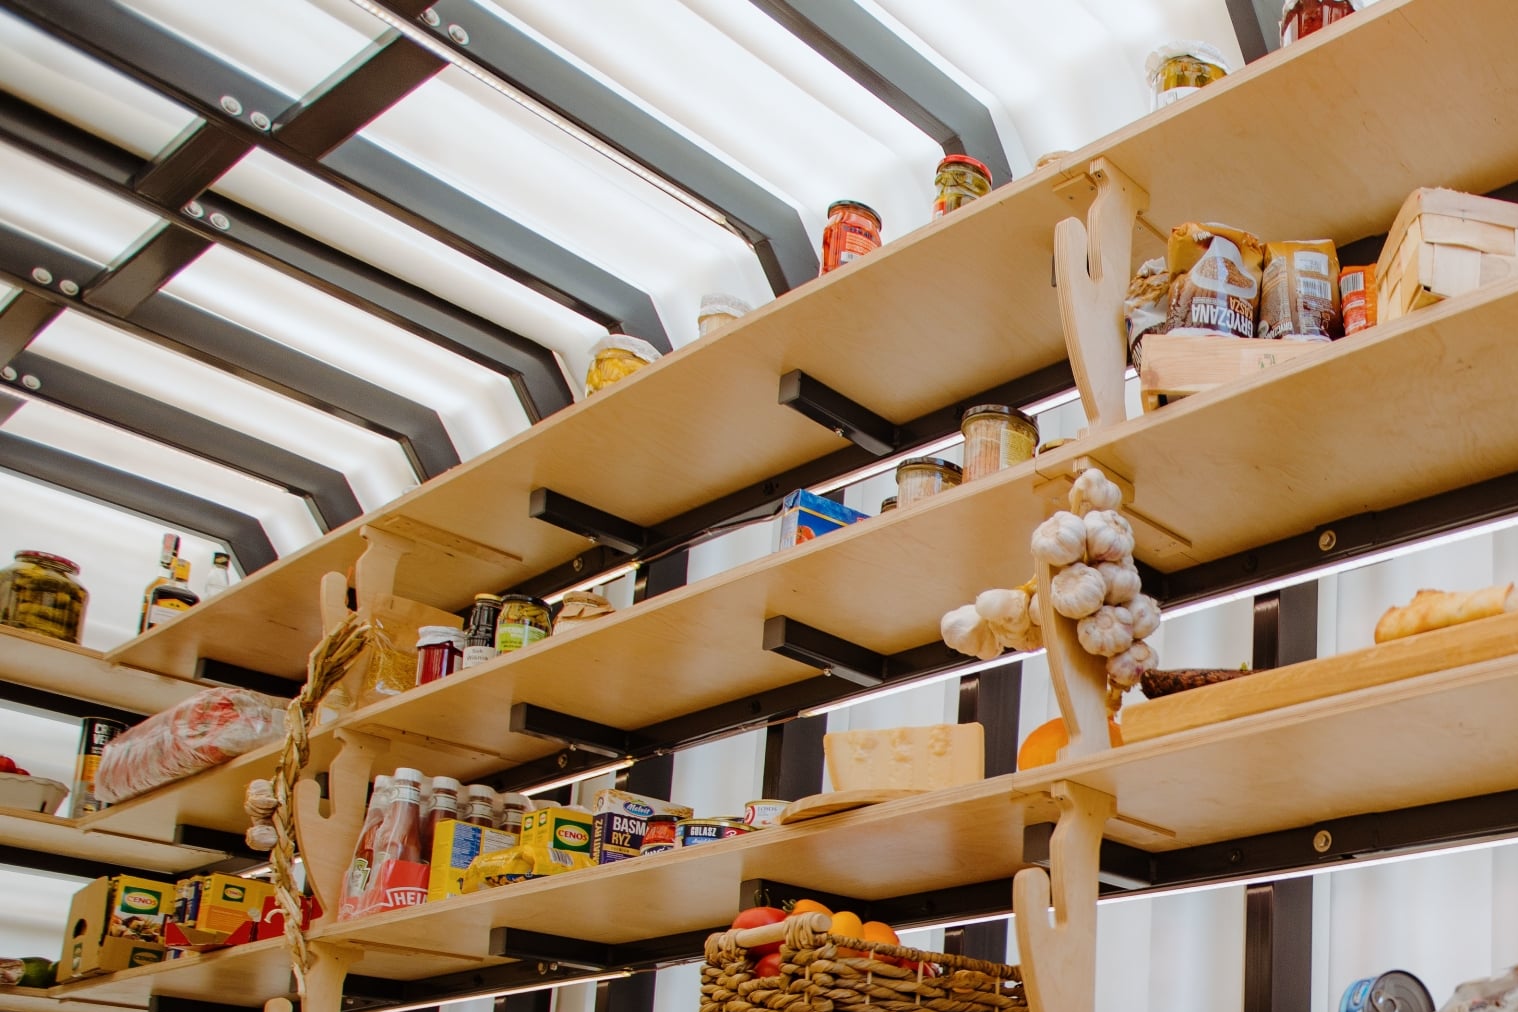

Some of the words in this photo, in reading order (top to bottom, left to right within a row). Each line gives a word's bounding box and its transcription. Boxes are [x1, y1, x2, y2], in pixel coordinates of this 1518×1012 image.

[613, 816, 649, 837] BASM
[690, 826, 717, 837] GULASZ
[558, 830, 588, 842] CENOS
[125, 894, 159, 907] CENOS
